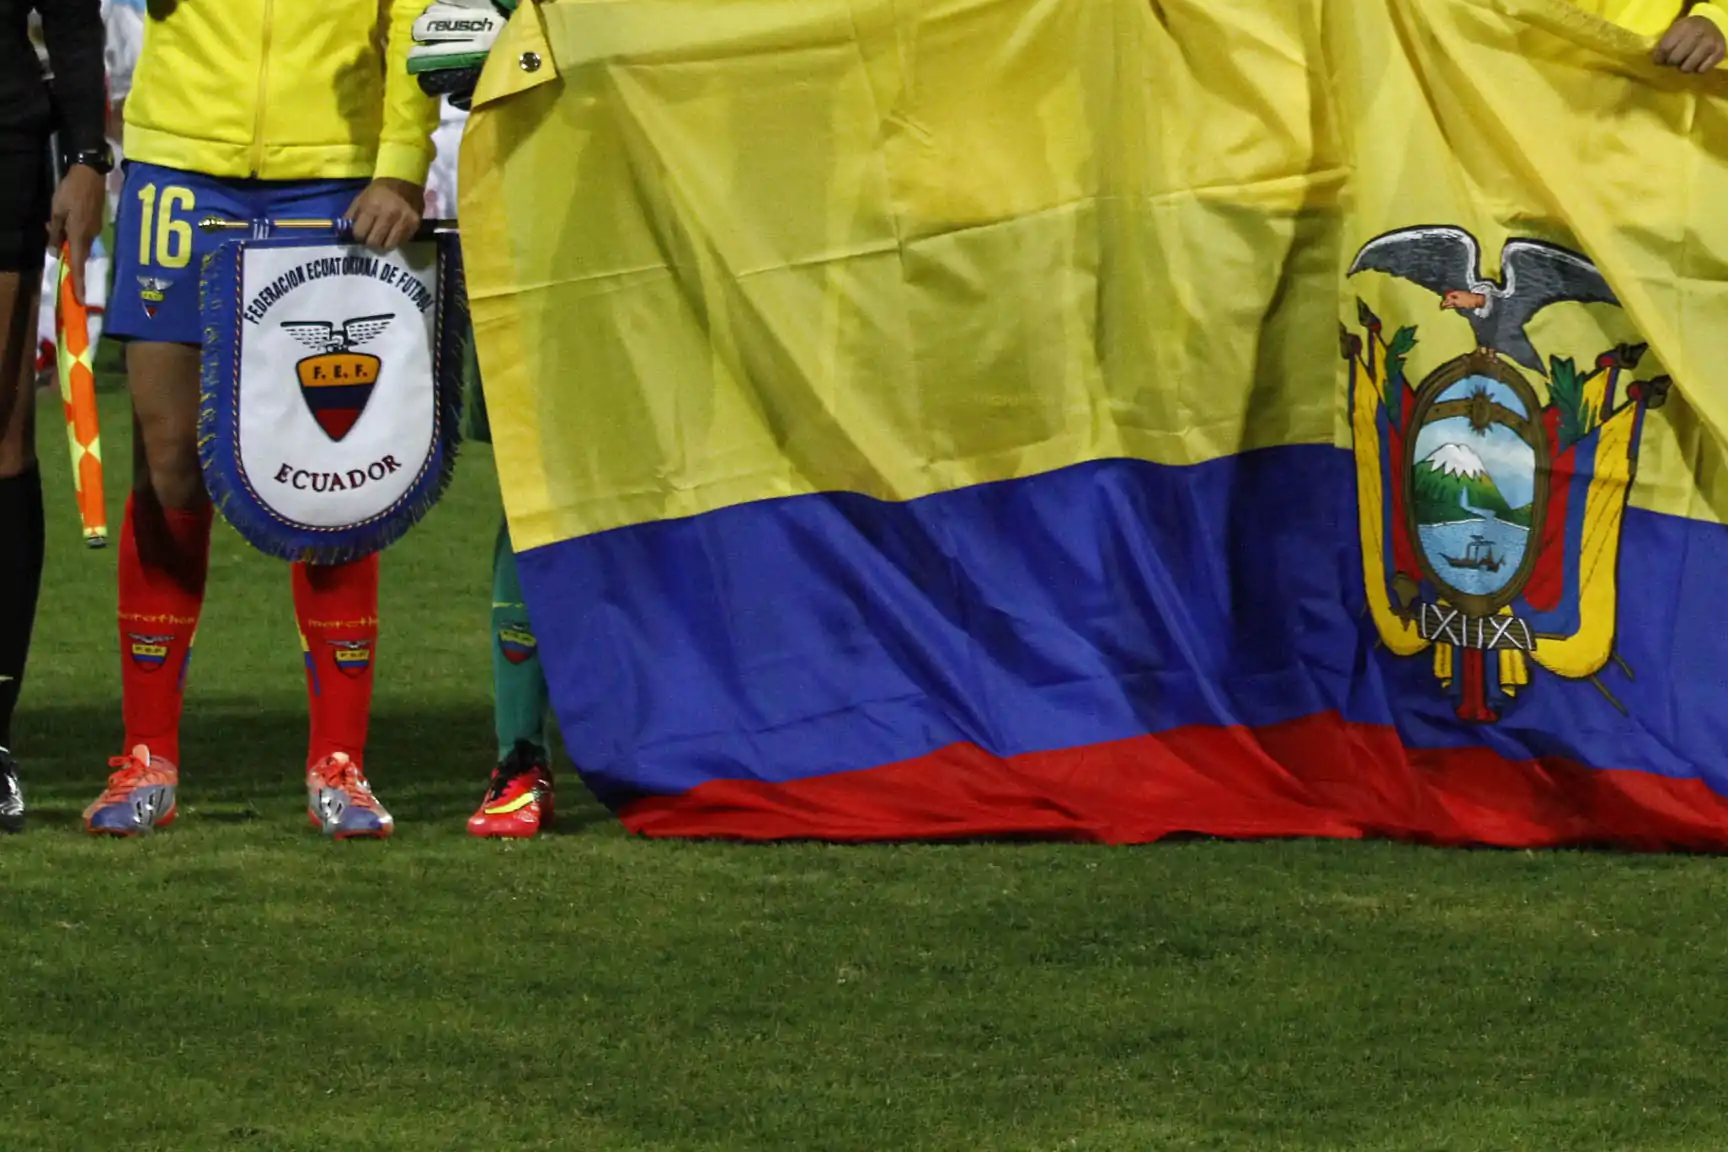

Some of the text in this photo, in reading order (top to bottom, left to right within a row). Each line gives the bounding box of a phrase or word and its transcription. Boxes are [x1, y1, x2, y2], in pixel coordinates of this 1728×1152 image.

[426, 17, 495, 33] reusch
[138, 182, 195, 268] 16
[244, 255, 435, 326] FEDERACION ECUATORIANA DE FUTBOL
[273, 454, 402, 493] ECUADOR
